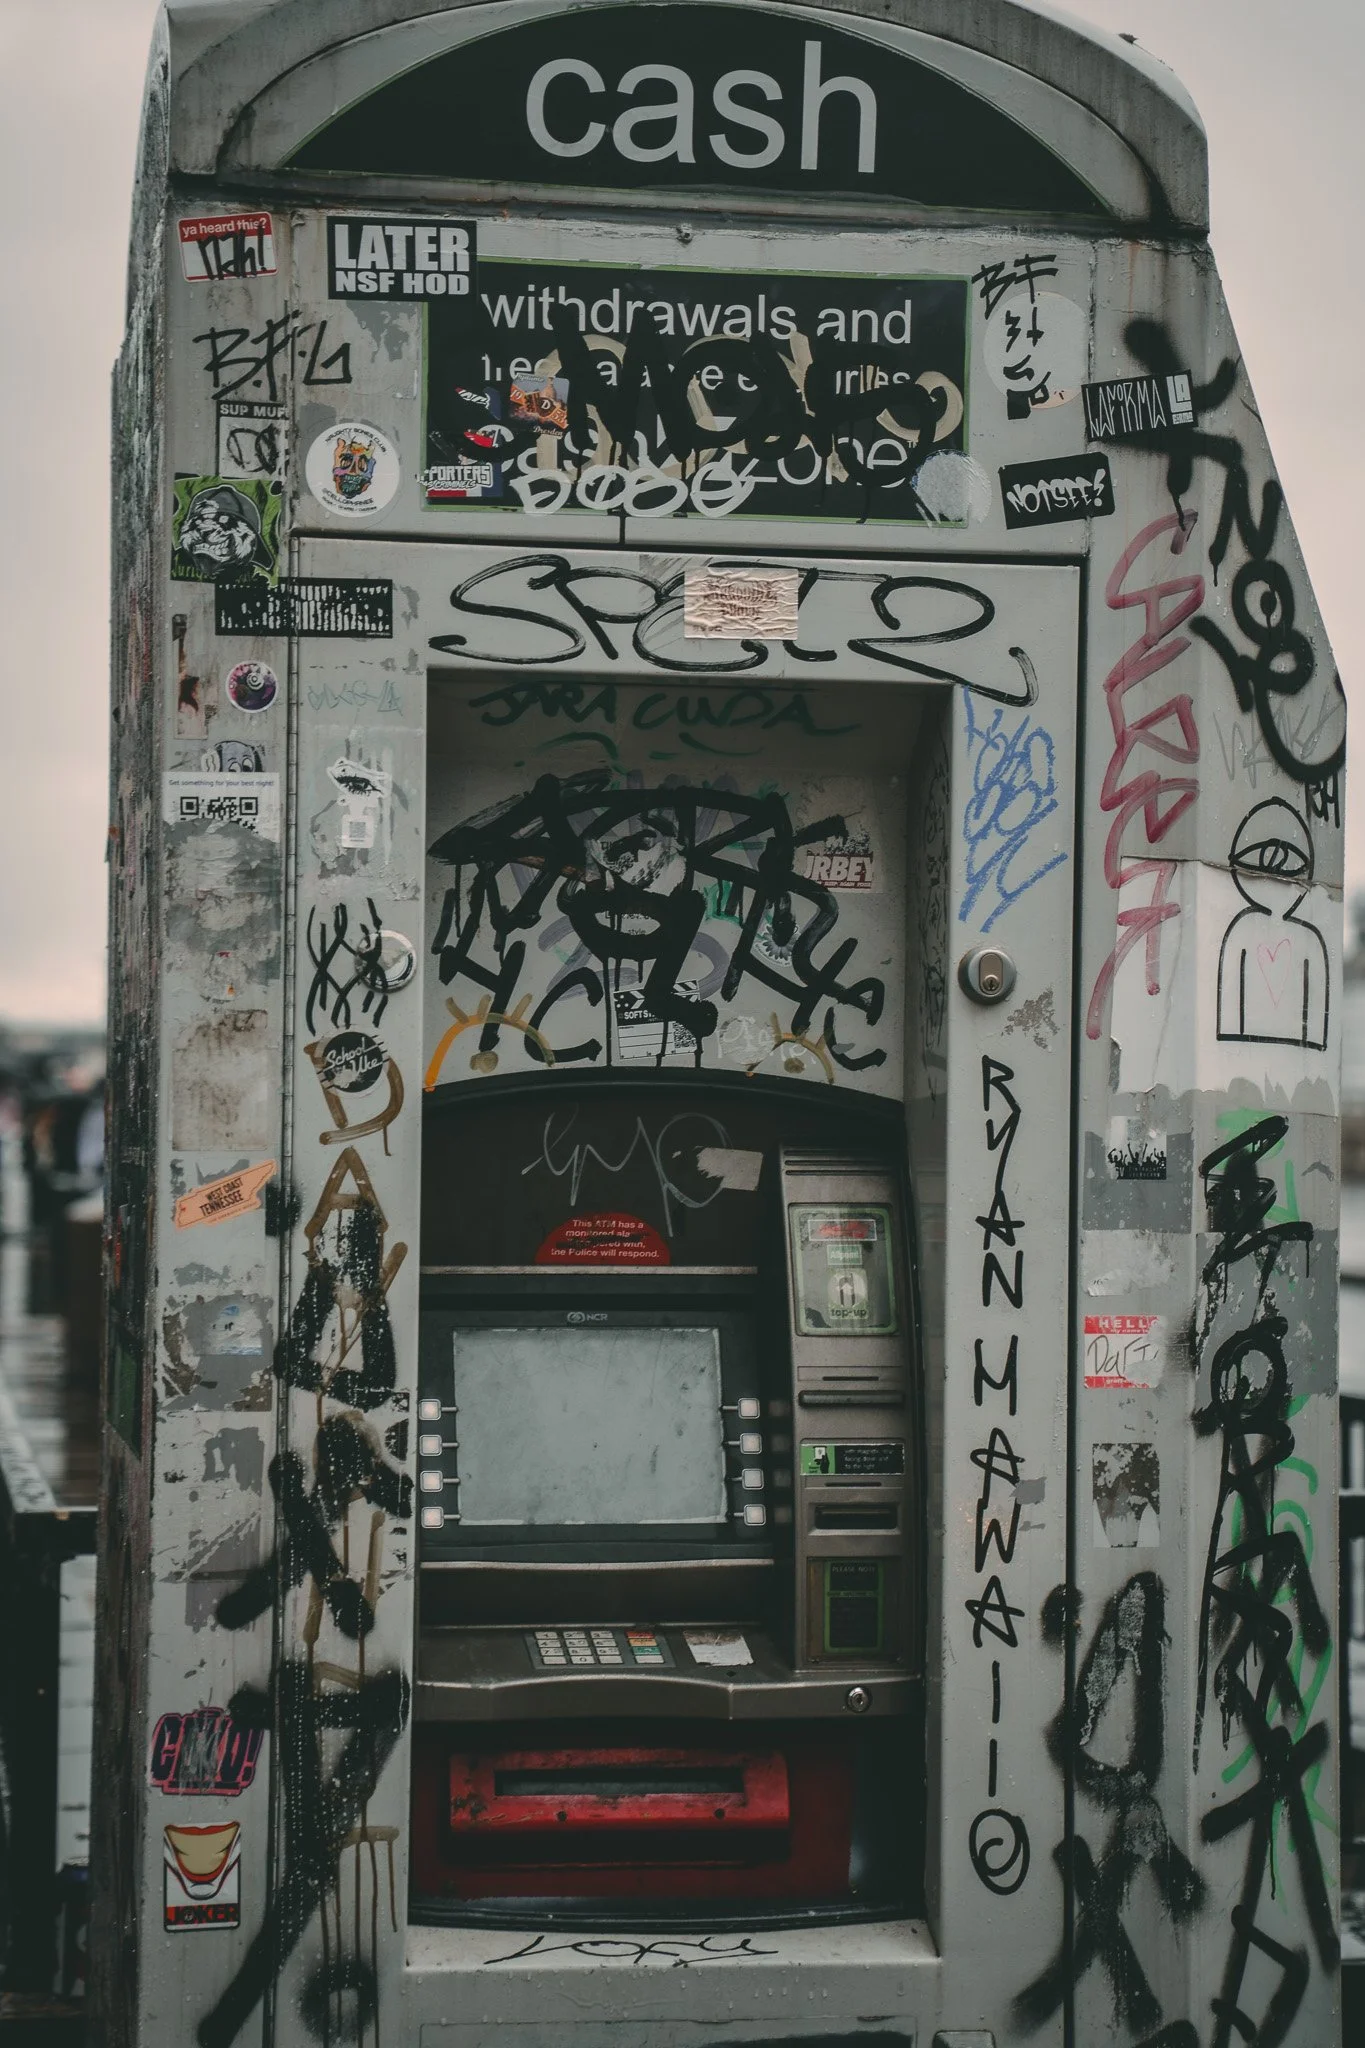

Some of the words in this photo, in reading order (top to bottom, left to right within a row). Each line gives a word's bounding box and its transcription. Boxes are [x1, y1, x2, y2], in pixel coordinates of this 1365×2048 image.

[525, 40, 877, 174] cash
[182, 225, 198, 238] ya
[200, 220, 235, 234] heard
[237, 216, 267, 232] this?
[334, 223, 470, 272] LATER
[335, 271, 395, 293] NSF
[403, 272, 470, 295] HOD
[481, 284, 798, 341] withdrawals
[816, 299, 912, 344] and
[220, 403, 248, 417] SUP
[181, 780, 214, 788] something
[223, 1177, 243, 1194] COAST
[199, 1189, 244, 1217] TENNESSEE
[572, 1219, 592, 1228] This
[595, 1220, 617, 1228] ATM
[618, 1220, 636, 1229] has
[568, 1248, 598, 1257] Police
[601, 1248, 617, 1257] will
[618, 1250, 660, 1259] respond.
[586, 1313, 609, 1321] NCR
[831, 1307, 868, 1319] top-up
[166, 1902, 239, 1925] JOKER
